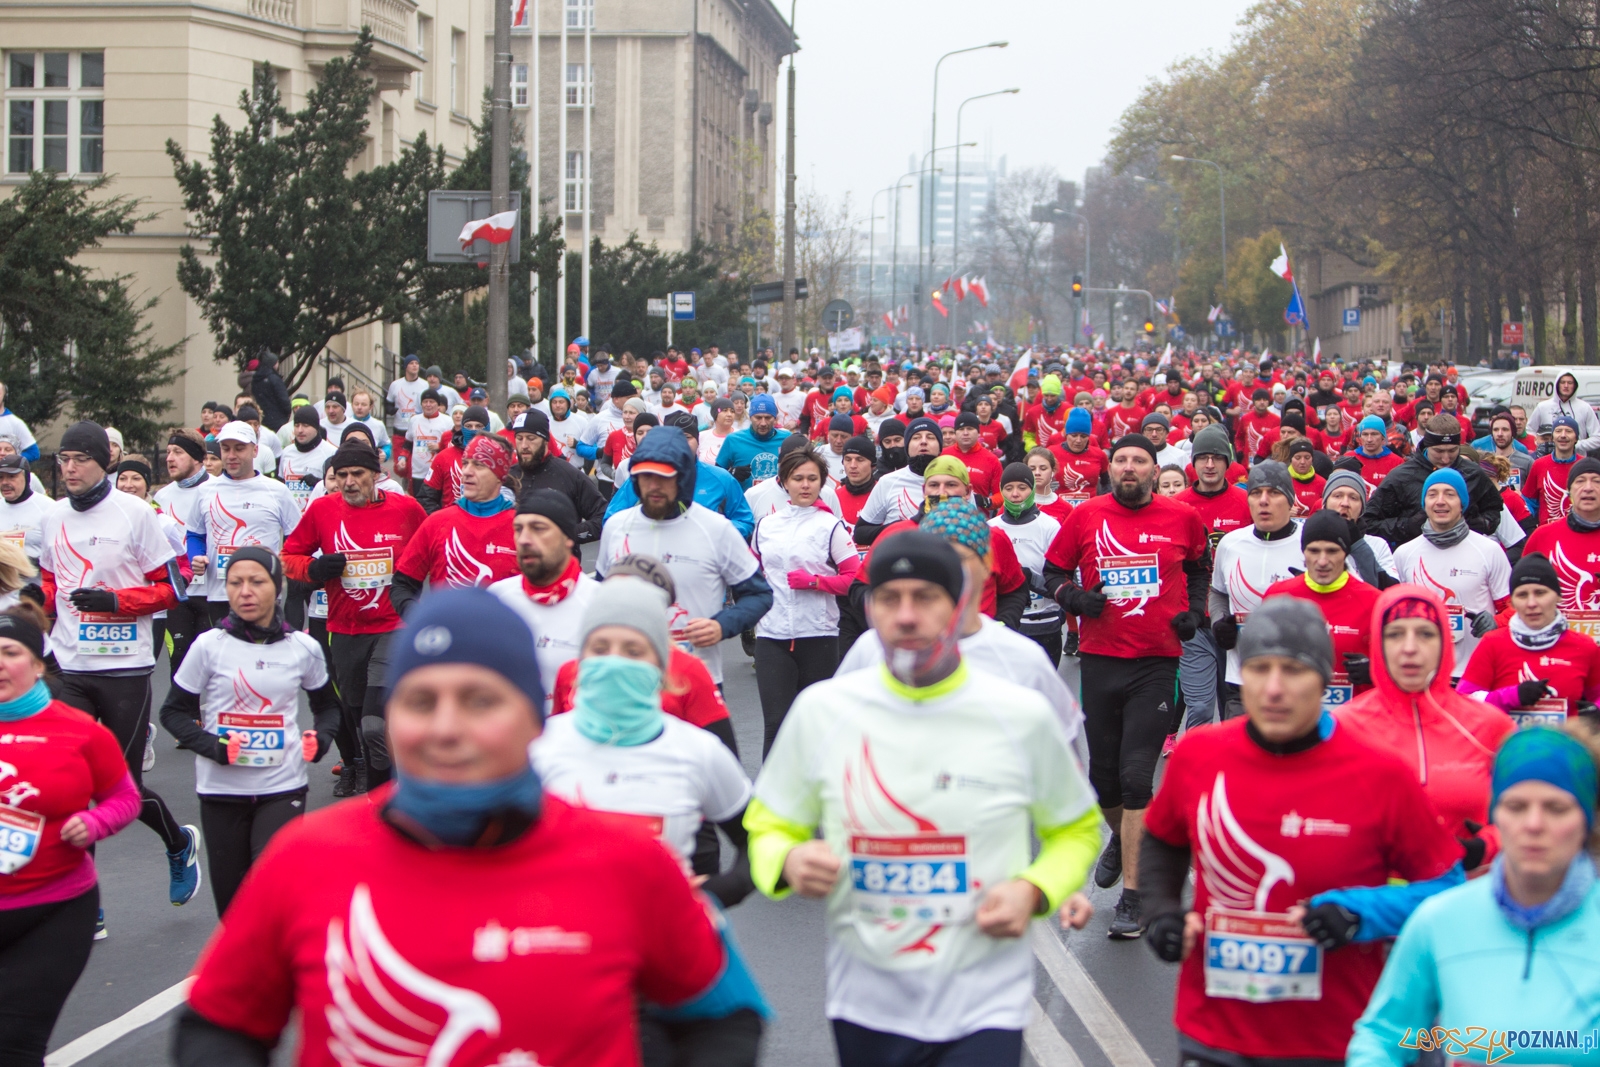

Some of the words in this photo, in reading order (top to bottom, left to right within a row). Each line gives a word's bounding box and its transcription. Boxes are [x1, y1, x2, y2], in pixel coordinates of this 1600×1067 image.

[1346, 310, 1357, 324] P
[346, 561, 388, 576] 9608
[1107, 568, 1151, 585] 9511
[85, 625, 132, 640] 6465
[1321, 689, 1345, 704] 23
[228, 730, 279, 749] 920
[863, 861, 959, 893] 8284
[1219, 939, 1309, 974] 9097
